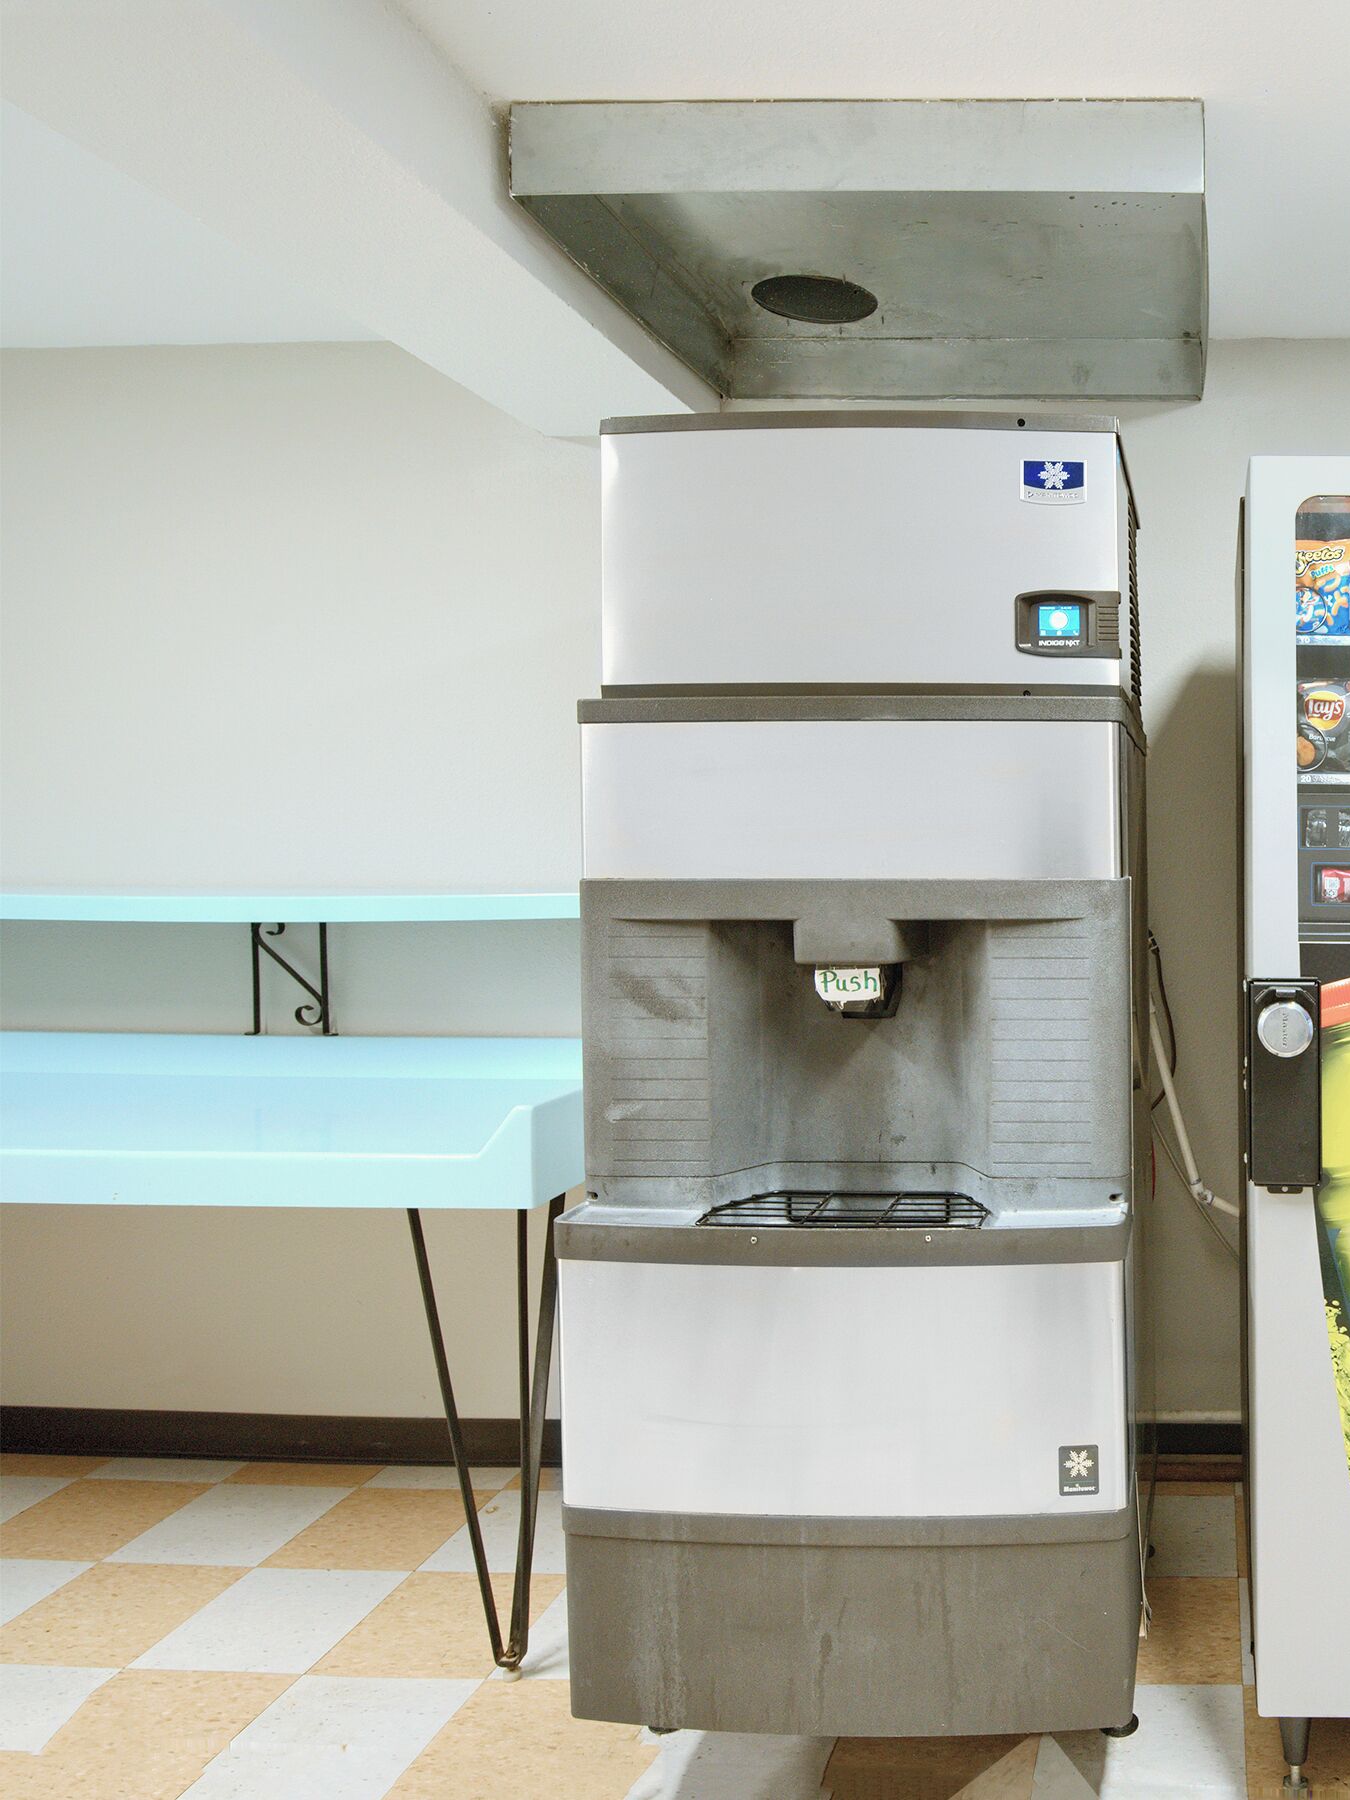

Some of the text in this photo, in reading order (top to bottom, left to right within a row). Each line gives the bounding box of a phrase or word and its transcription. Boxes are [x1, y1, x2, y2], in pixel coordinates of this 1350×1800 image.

[1310, 564, 1334, 579] Puffs
[1308, 700, 1343, 721] Lay's
[1300, 775, 1312, 783] 20
[819, 970, 878, 993] Push
